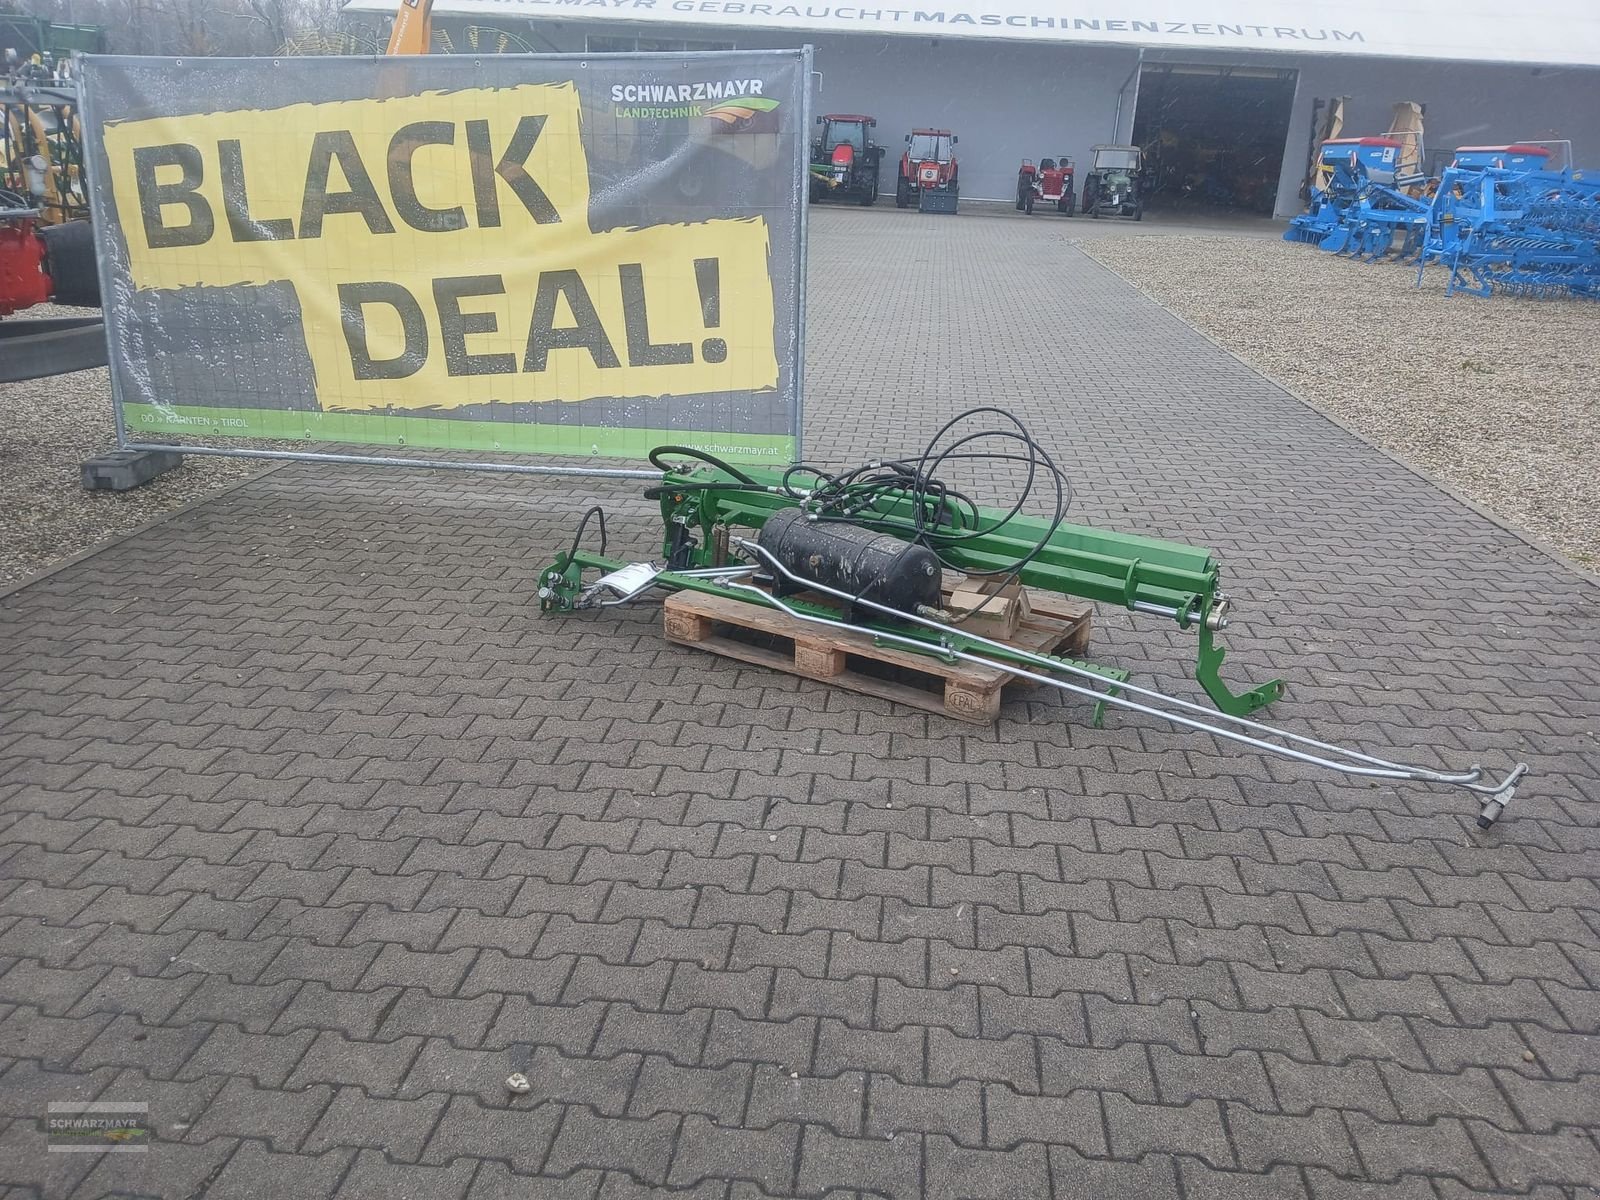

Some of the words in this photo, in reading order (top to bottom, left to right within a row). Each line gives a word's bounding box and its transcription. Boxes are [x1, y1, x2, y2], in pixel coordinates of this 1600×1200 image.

[672, 0, 1366, 42] GEBRAUCHTMASCHINENZENTRUM
[611, 79, 763, 103] SCHWARZMAYR
[615, 105, 703, 119] LANDTECHNIK
[133, 114, 562, 249] BLACK
[336, 257, 727, 381] DEAL!
[220, 417, 249, 428] TIROL
[953, 695, 980, 711] EPAL
